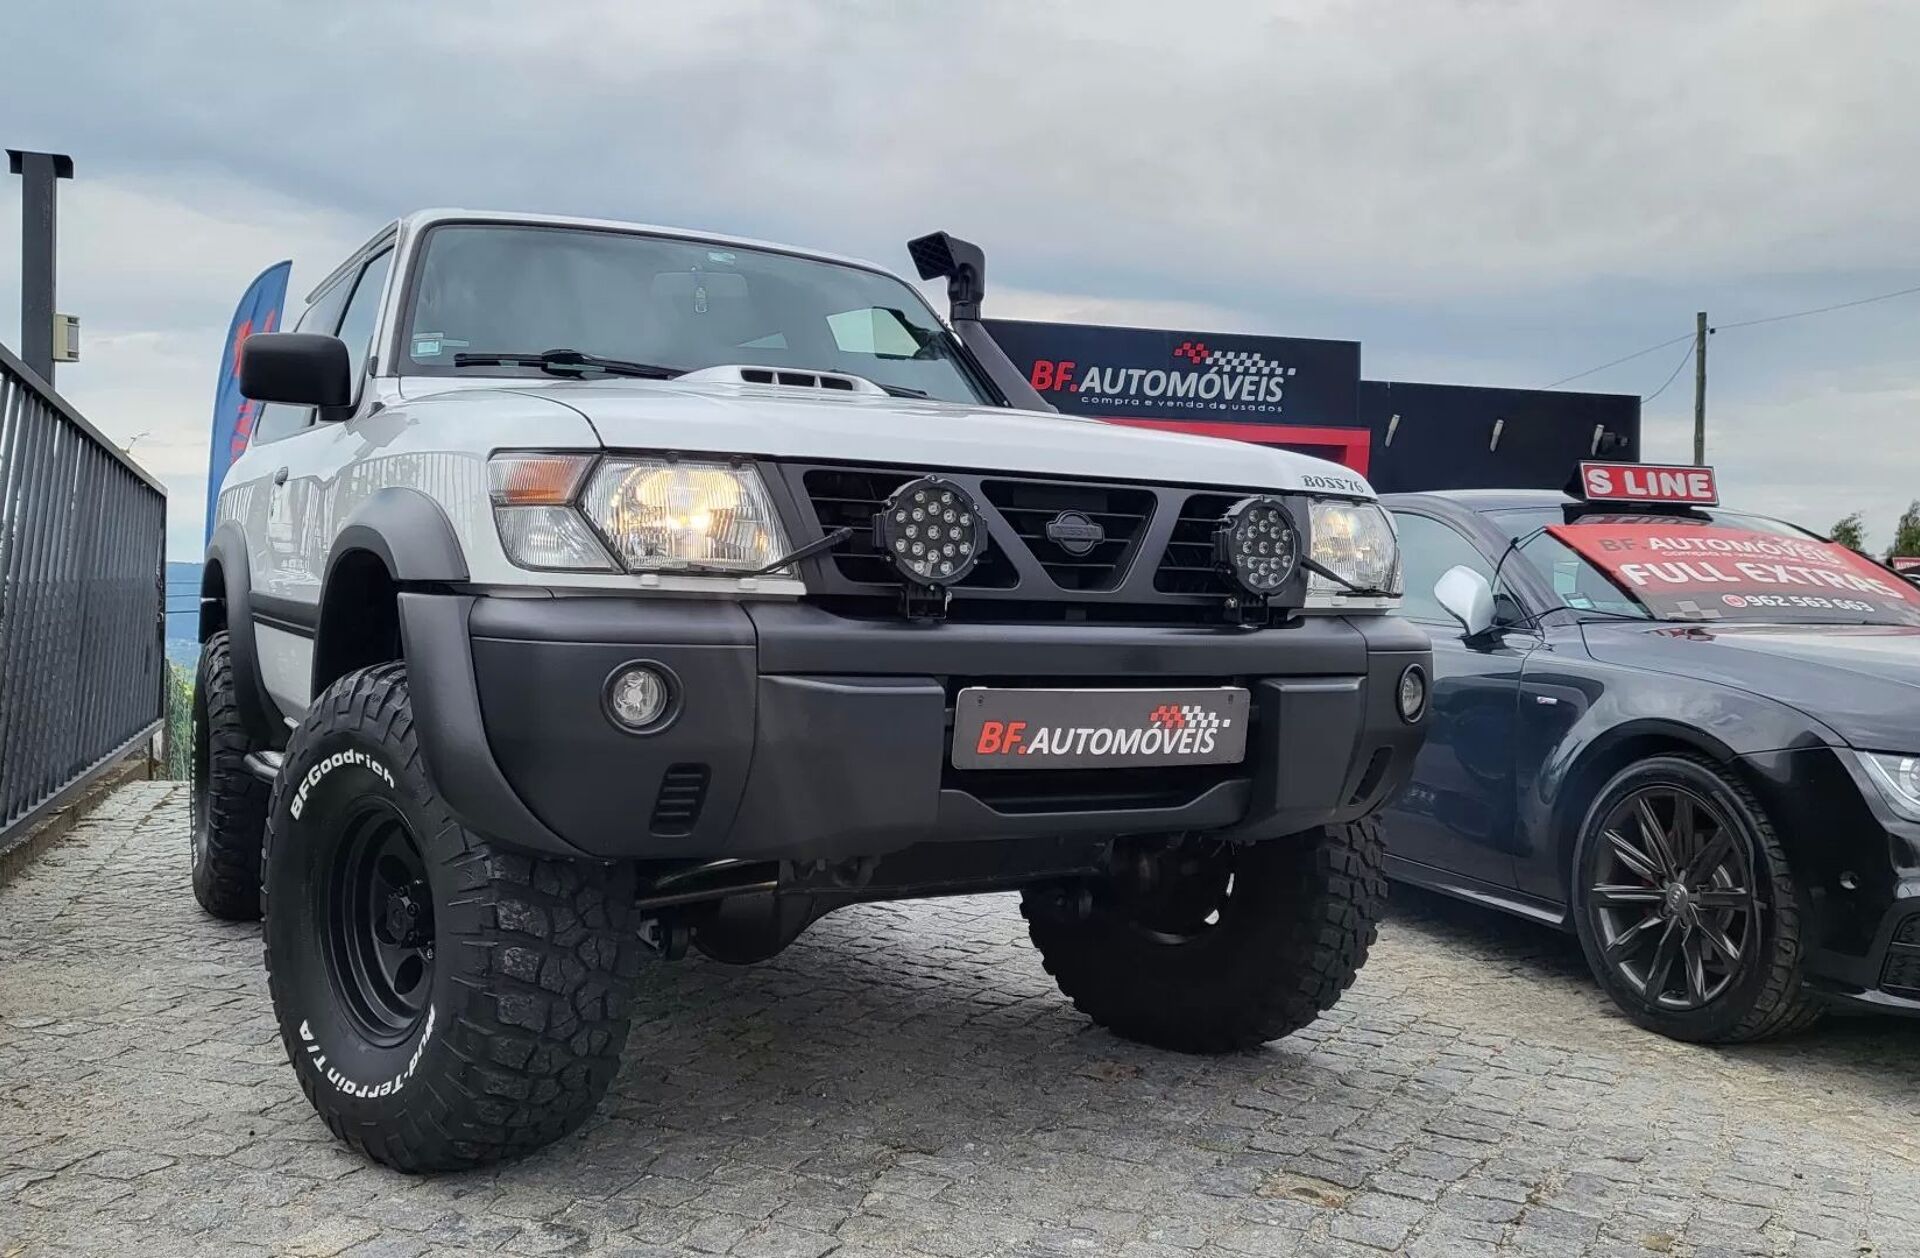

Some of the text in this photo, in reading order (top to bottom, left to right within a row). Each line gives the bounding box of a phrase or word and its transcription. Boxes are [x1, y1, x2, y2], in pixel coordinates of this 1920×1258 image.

[1081, 396, 1140, 406] compra
[1158, 400, 1204, 409] venda
[1209, 402, 1226, 410] de
[1231, 404, 1283, 413] usados
[1587, 468, 1712, 498] S LINE
[1620, 562, 1905, 599] FULL EXTRAS
[1745, 595, 1790, 606] 962
[1788, 596, 1833, 608] 563
[976, 720, 1218, 756] BF.AUTOMÓVEIS
[290, 748, 394, 820] BFGoodrich
[299, 1018, 326, 1073] T/A
